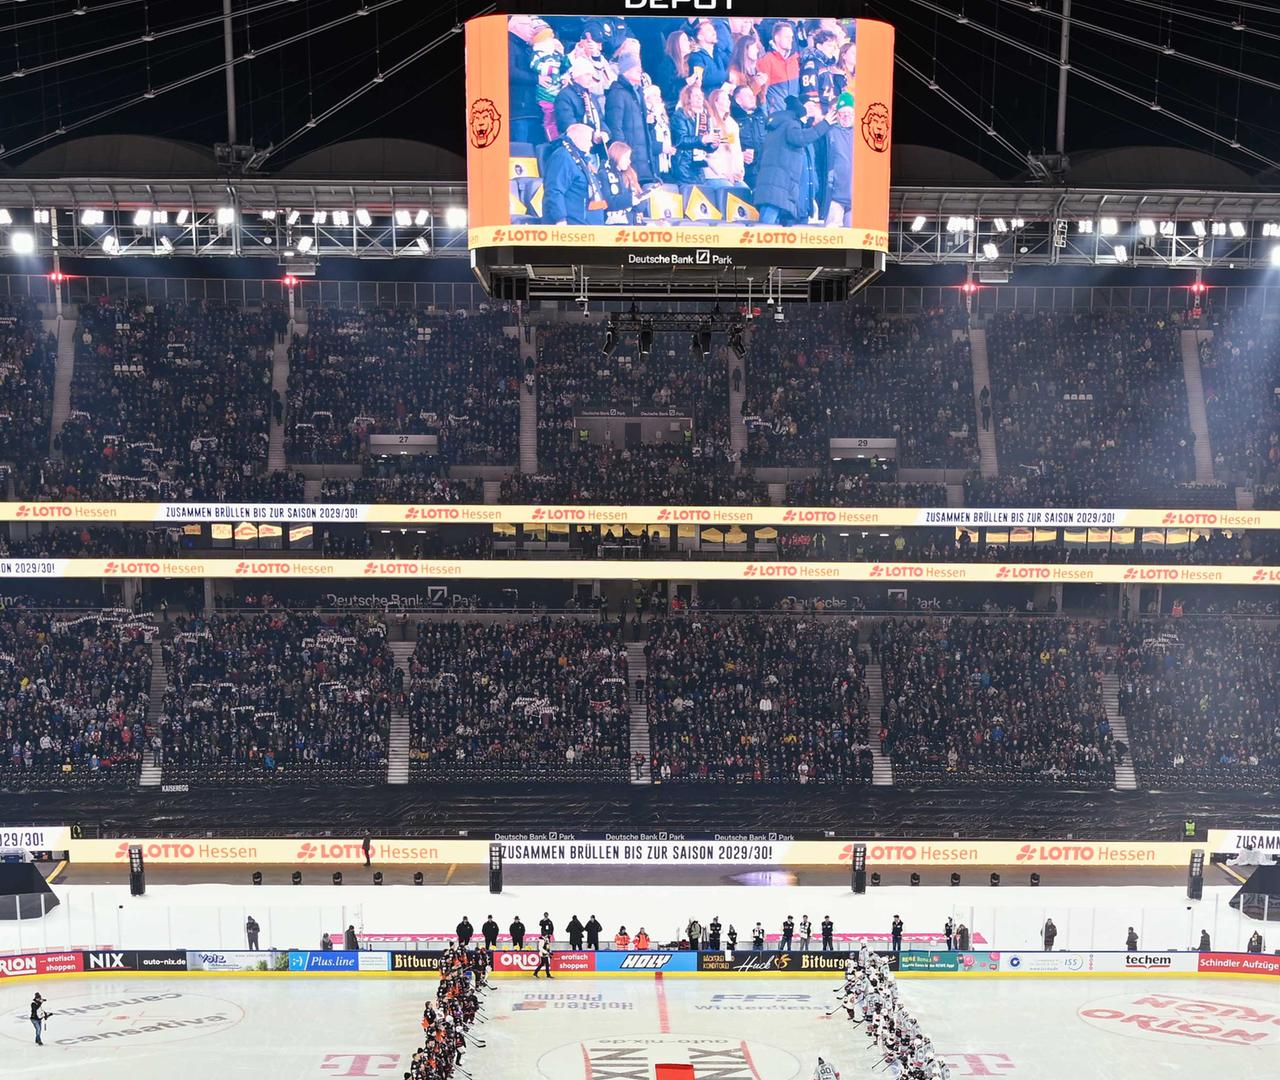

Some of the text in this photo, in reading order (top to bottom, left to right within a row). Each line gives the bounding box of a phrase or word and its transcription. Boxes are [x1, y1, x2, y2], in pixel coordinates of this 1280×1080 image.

[508, 230, 594, 242] LOTTO Hessen
[633, 231, 719, 243] LOTTO Hessen
[628, 254, 732, 265] Deutsche Bank Park
[760, 566, 839, 576] LOTTO Hessen
[495, 833, 575, 841] Deutsche Bank Park
[606, 833, 685, 841] Deutsche Bank Park
[1040, 846, 1155, 861] LOTTO Hessen
[47, 955, 76, 964] erotisch
[89, 952, 186, 968] NIX auto-nix.de
[309, 953, 354, 966] Plus.line
[620, 954, 672, 968] HOLY
[1126, 955, 1171, 966] techem
[1200, 956, 1280, 972] Schindler Aufzüge
[45, 963, 76, 973] shoppen
[54, 1011, 226, 1048] cansativa
[1081, 1007, 1268, 1045] ORION
